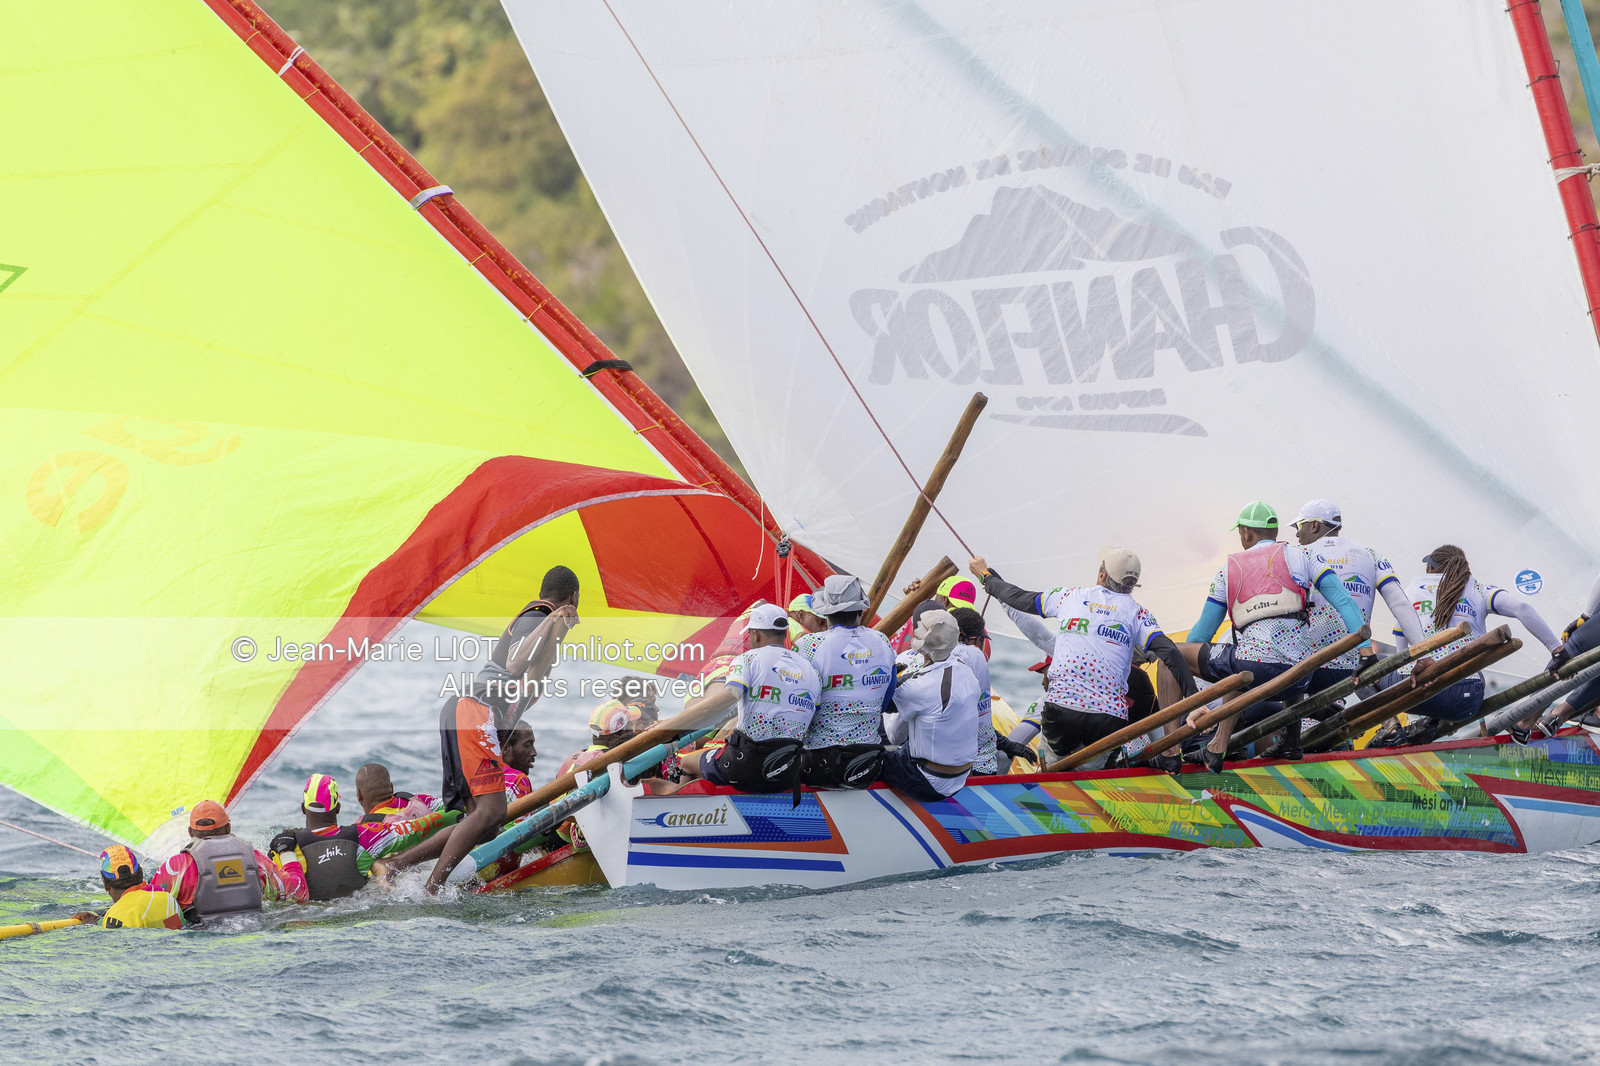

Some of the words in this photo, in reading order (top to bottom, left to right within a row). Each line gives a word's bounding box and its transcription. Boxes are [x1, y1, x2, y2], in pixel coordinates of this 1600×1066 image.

[1060, 617, 1090, 633] UFR
[1097, 623, 1132, 648] CHANFLOR
[749, 685, 782, 701] UFR
[788, 693, 815, 711] CHANFLOR
[1412, 793, 1437, 811] Mèsi
[1439, 801, 1453, 811] an
